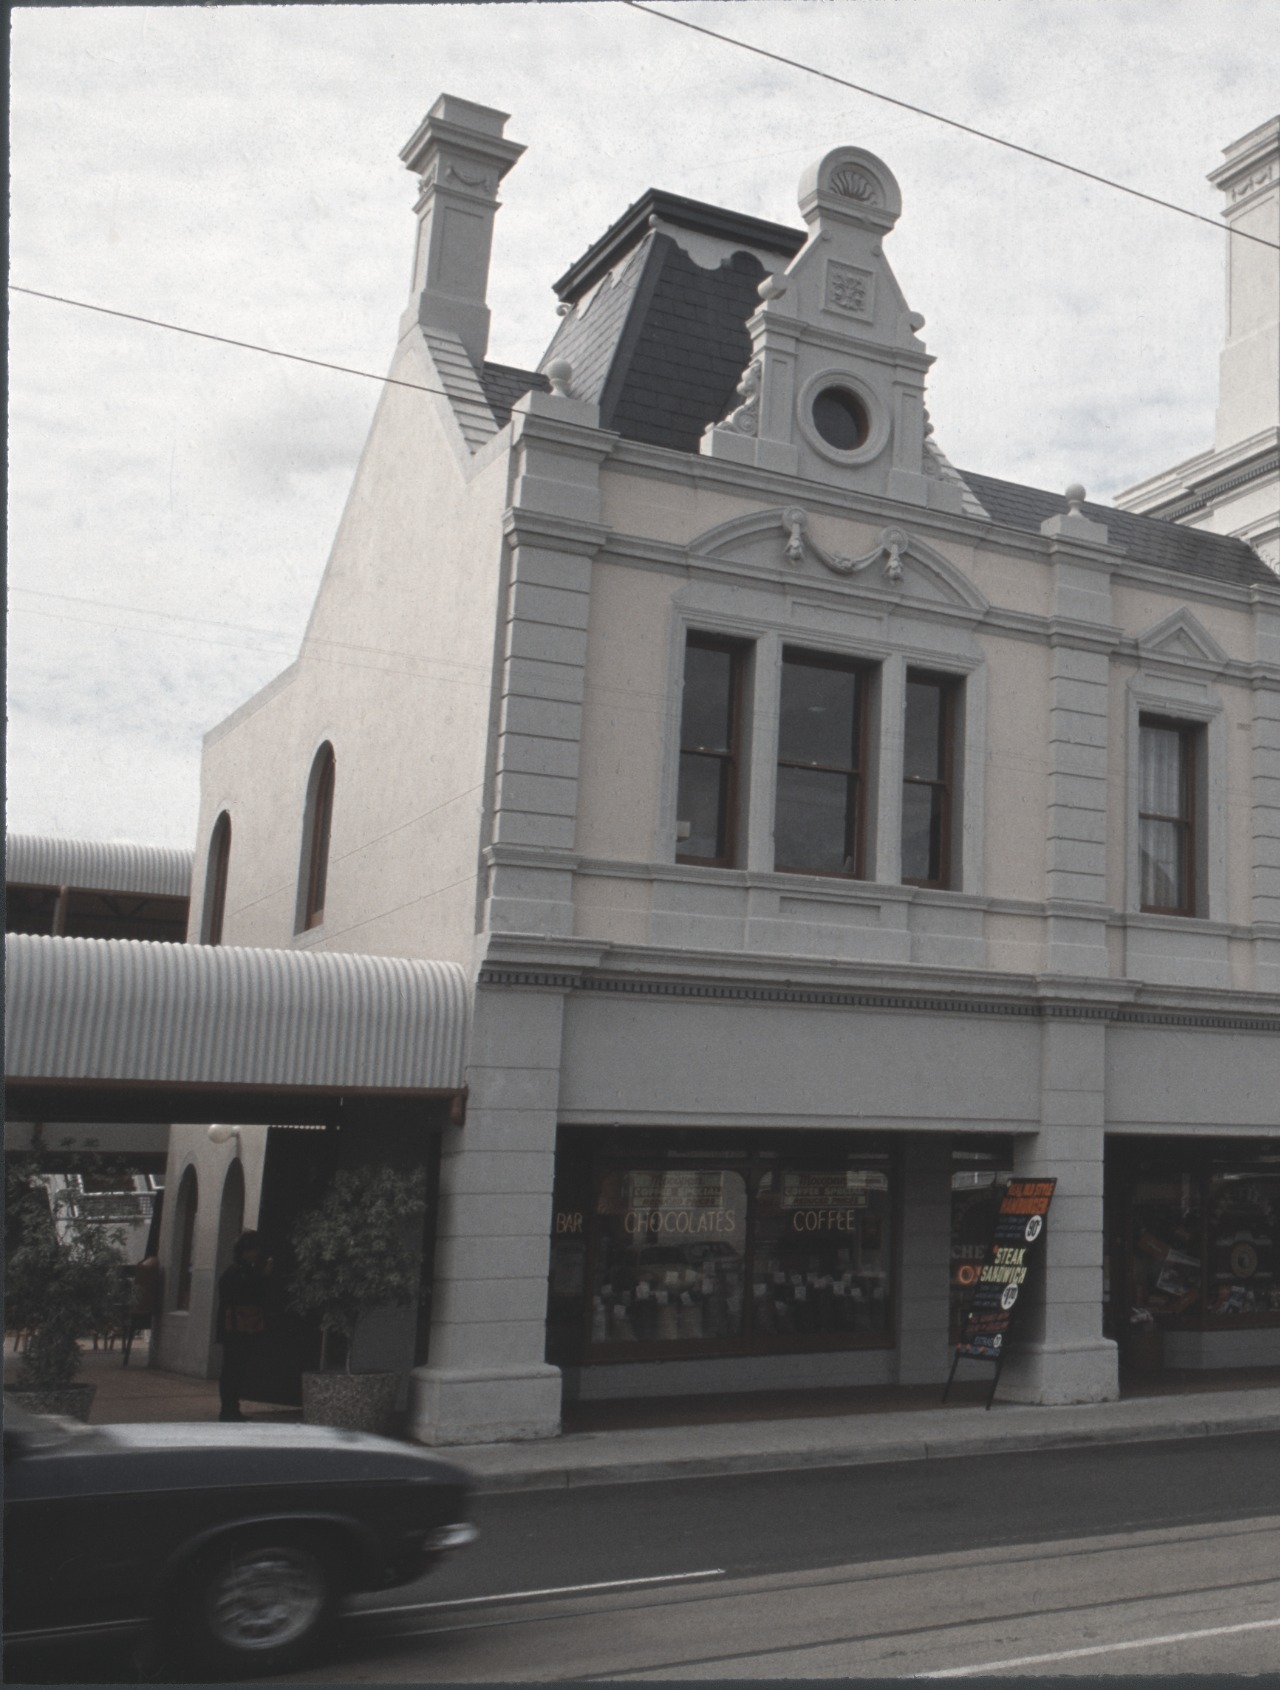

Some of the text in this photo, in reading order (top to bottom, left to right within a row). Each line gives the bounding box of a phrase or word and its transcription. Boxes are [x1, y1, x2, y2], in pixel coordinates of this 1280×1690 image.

[556, 1211, 584, 1233] BAR
[624, 1209, 737, 1233] CHOCOLATES
[792, 1209, 857, 1232] COFFEE
[994, 1247, 1026, 1265] STEAK
[980, 1265, 1028, 1284] SANDWICH
